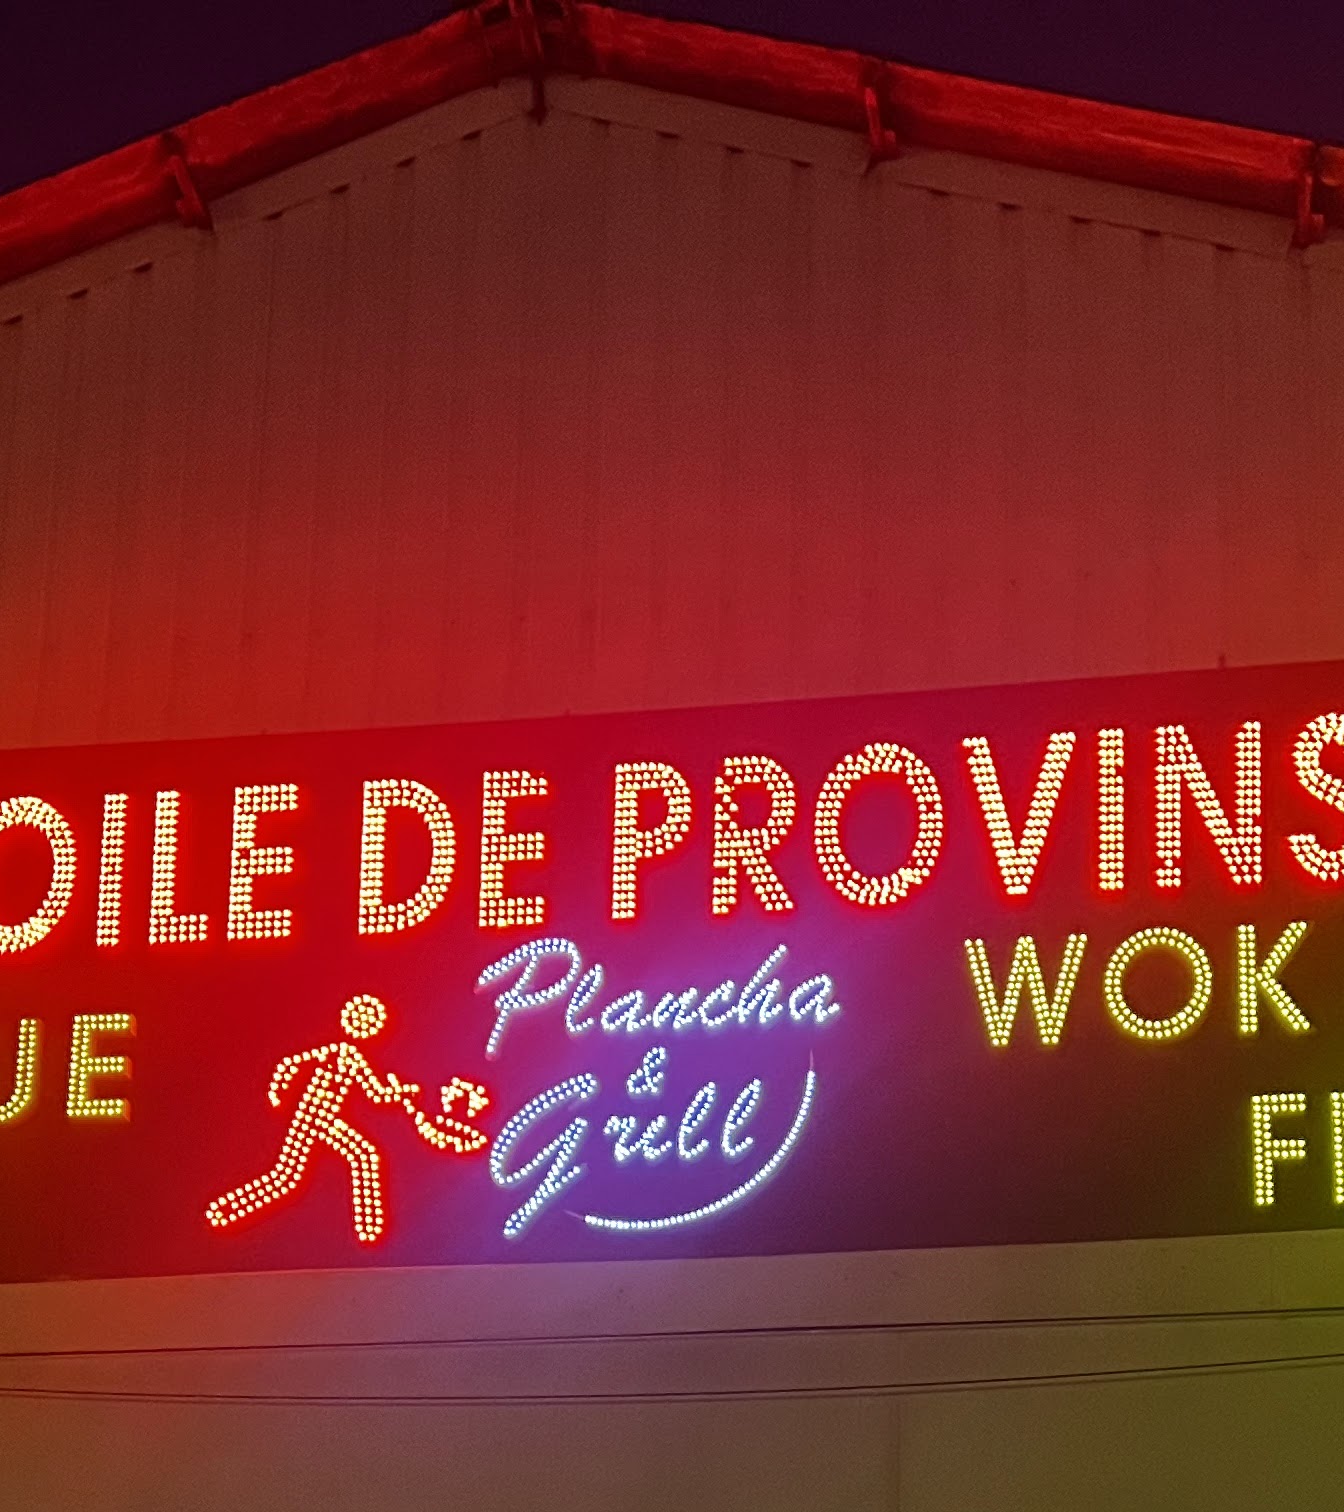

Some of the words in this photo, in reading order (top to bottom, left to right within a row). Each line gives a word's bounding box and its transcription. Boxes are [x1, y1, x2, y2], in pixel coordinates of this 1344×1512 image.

[358, 770, 547, 934] DE
[476, 936, 842, 1056] Plancha
[964, 921, 1312, 1047] WOK
[625, 1045, 667, 1097] &
[486, 1072, 763, 1238] Grill
